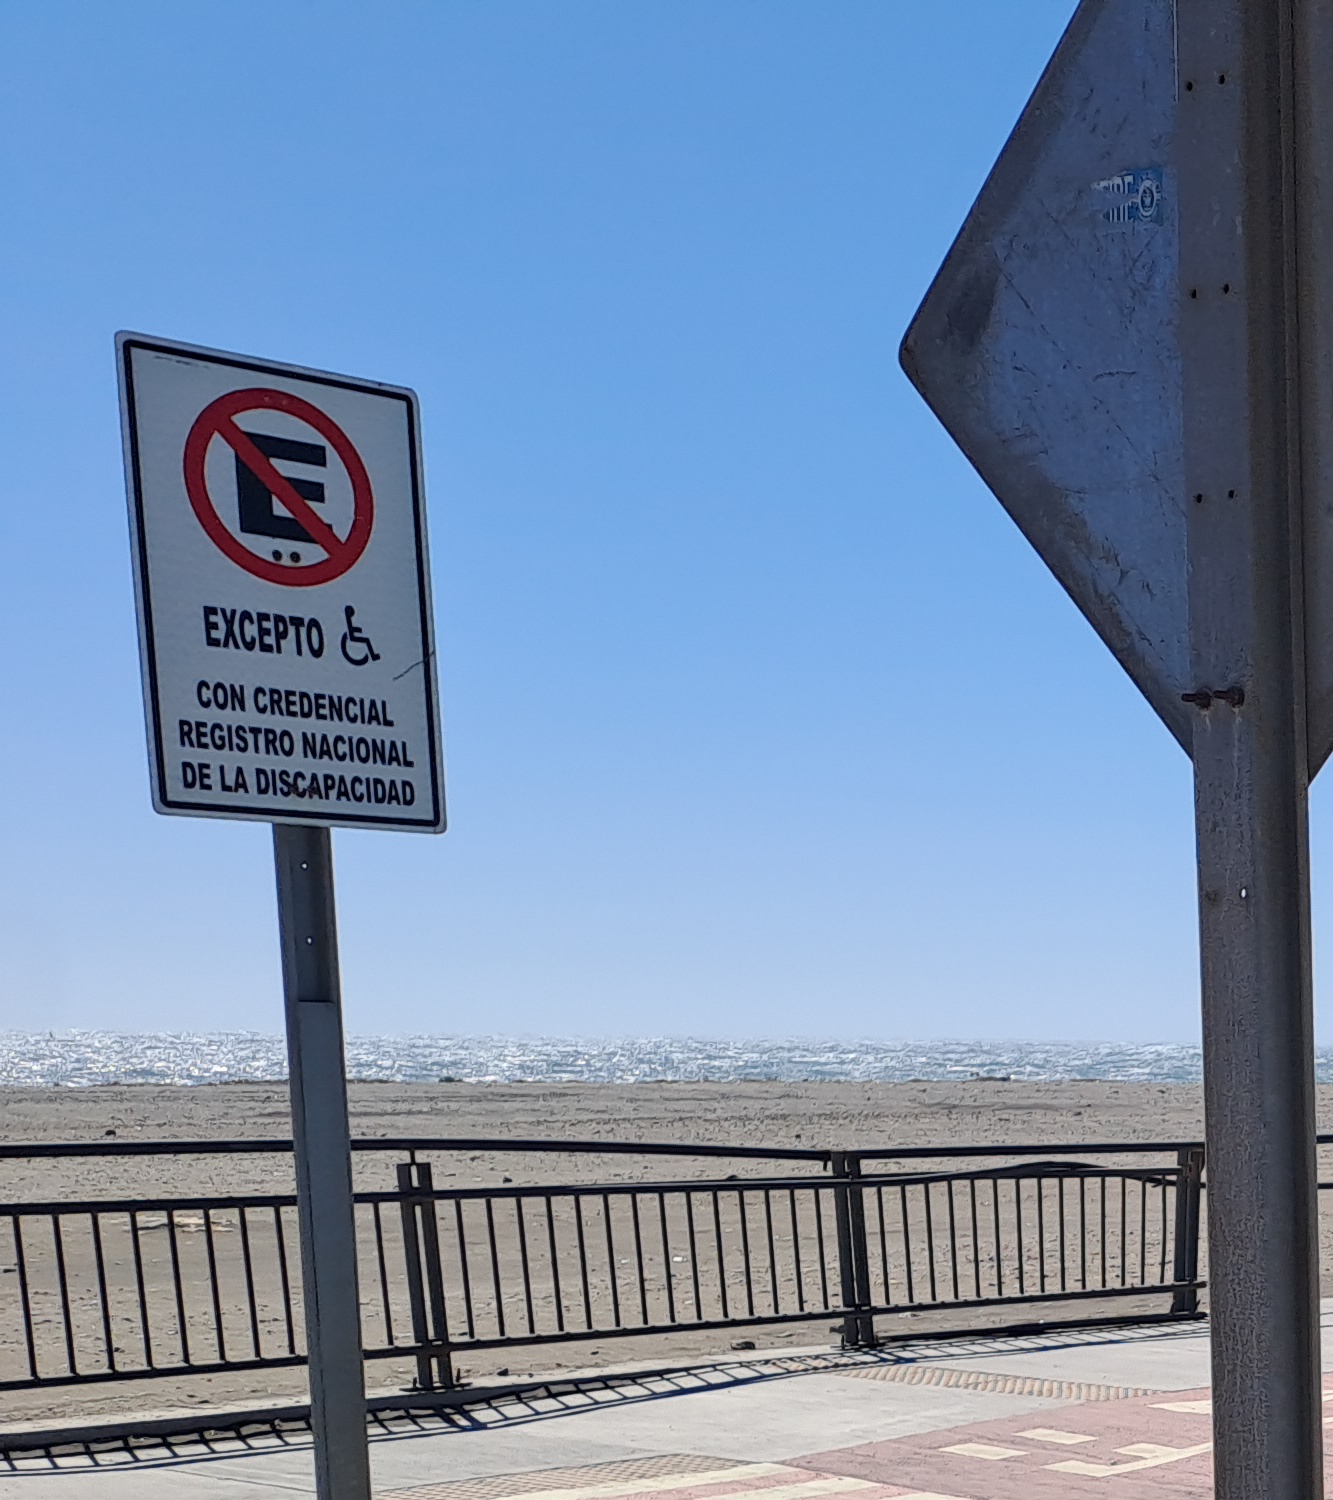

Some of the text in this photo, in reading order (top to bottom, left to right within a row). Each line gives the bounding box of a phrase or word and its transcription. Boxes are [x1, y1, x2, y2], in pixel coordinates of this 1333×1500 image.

[235, 431, 332, 544] E
[202, 605, 325, 659] EXCEPTO
[196, 679, 395, 727] CON CREDENCIAL
[178, 719, 414, 768] REGISTRO NACIONAL
[181, 761, 416, 806] DE LA DISCAPACIDAD
